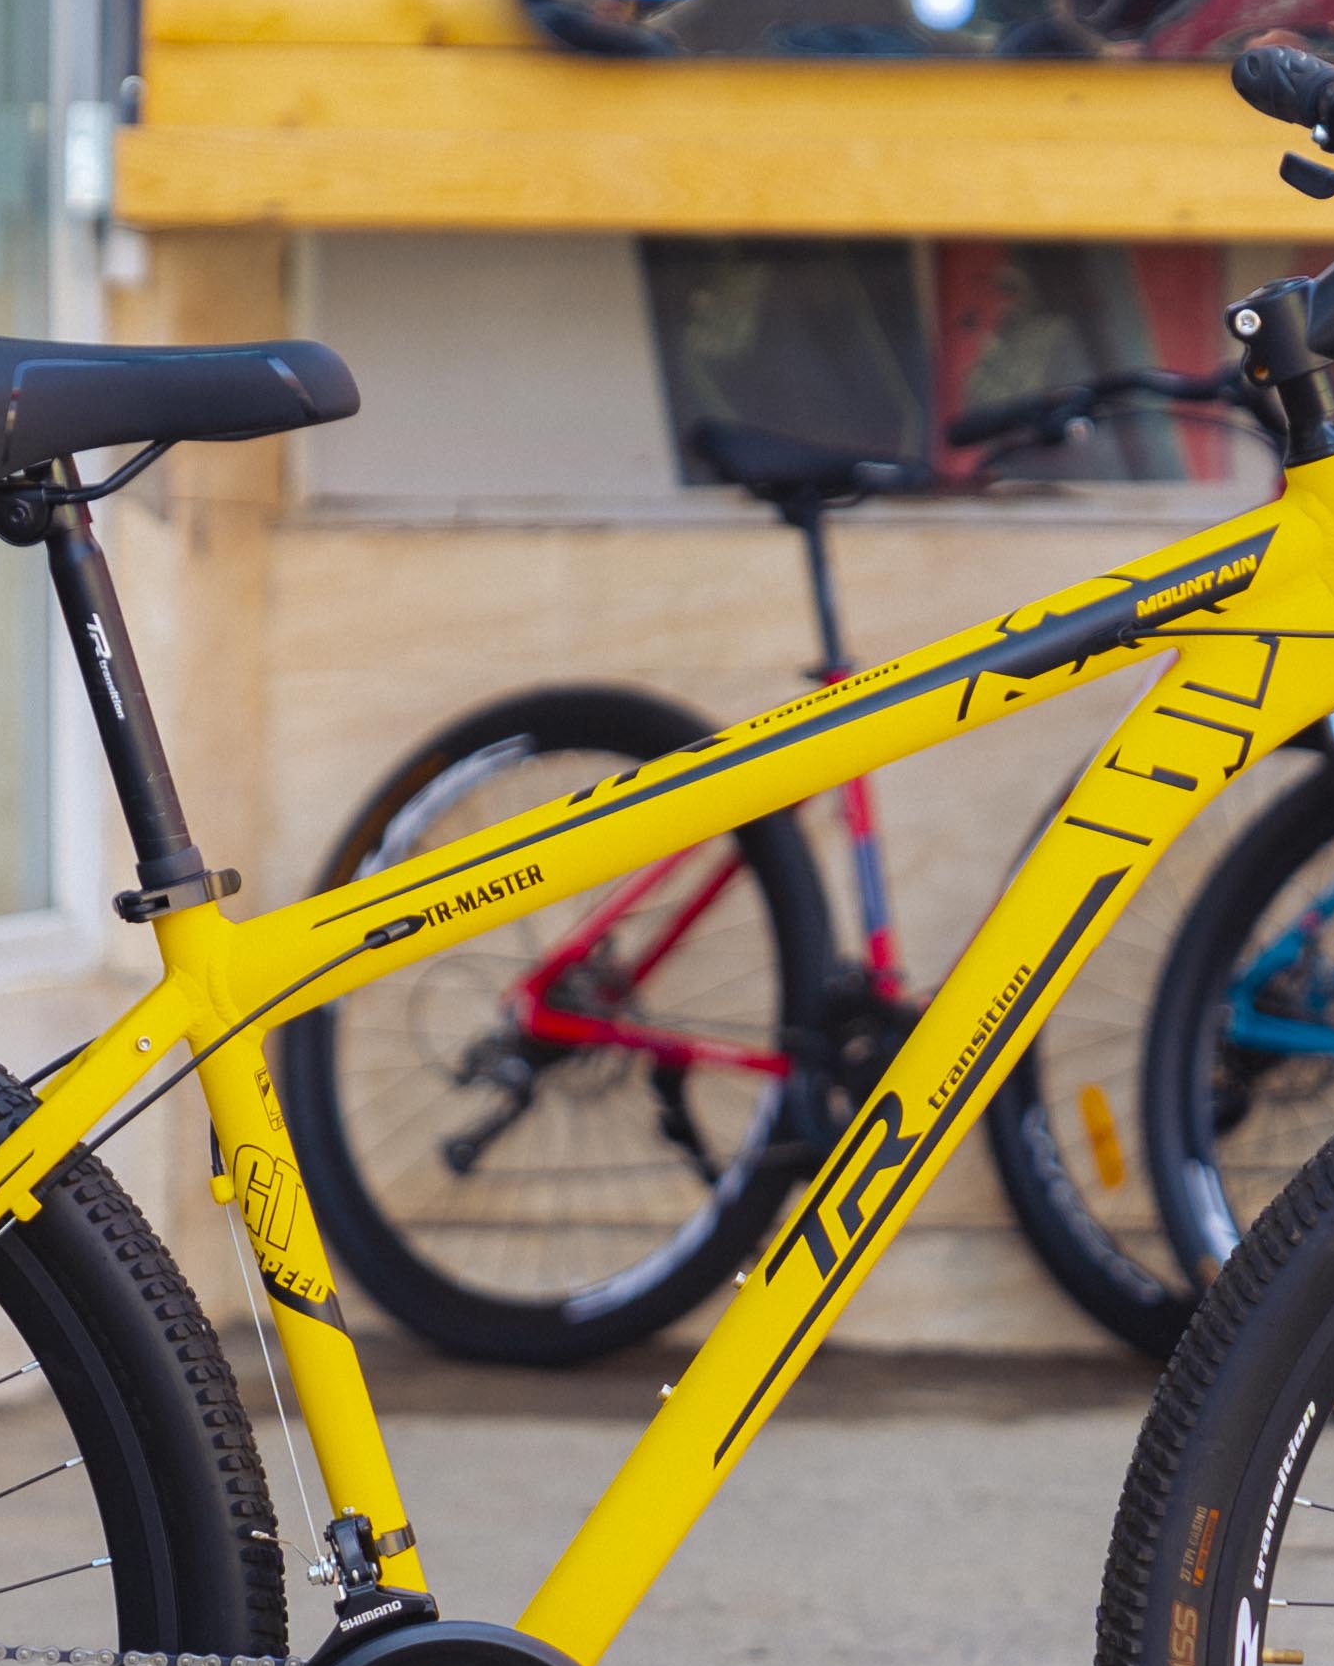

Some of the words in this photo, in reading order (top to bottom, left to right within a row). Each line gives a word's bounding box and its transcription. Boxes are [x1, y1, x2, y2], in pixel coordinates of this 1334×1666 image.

[1135, 553, 1258, 618] MOUNTAIN
[86, 612, 113, 660] TR
[98, 658, 126, 719] transition
[421, 863, 545, 927] TR-MASTER
[765, 1090, 925, 1288] TR
[927, 962, 1032, 1112] transition
[1254, 1399, 1317, 1591] transition
[339, 1599, 403, 1632] SHIMANO
